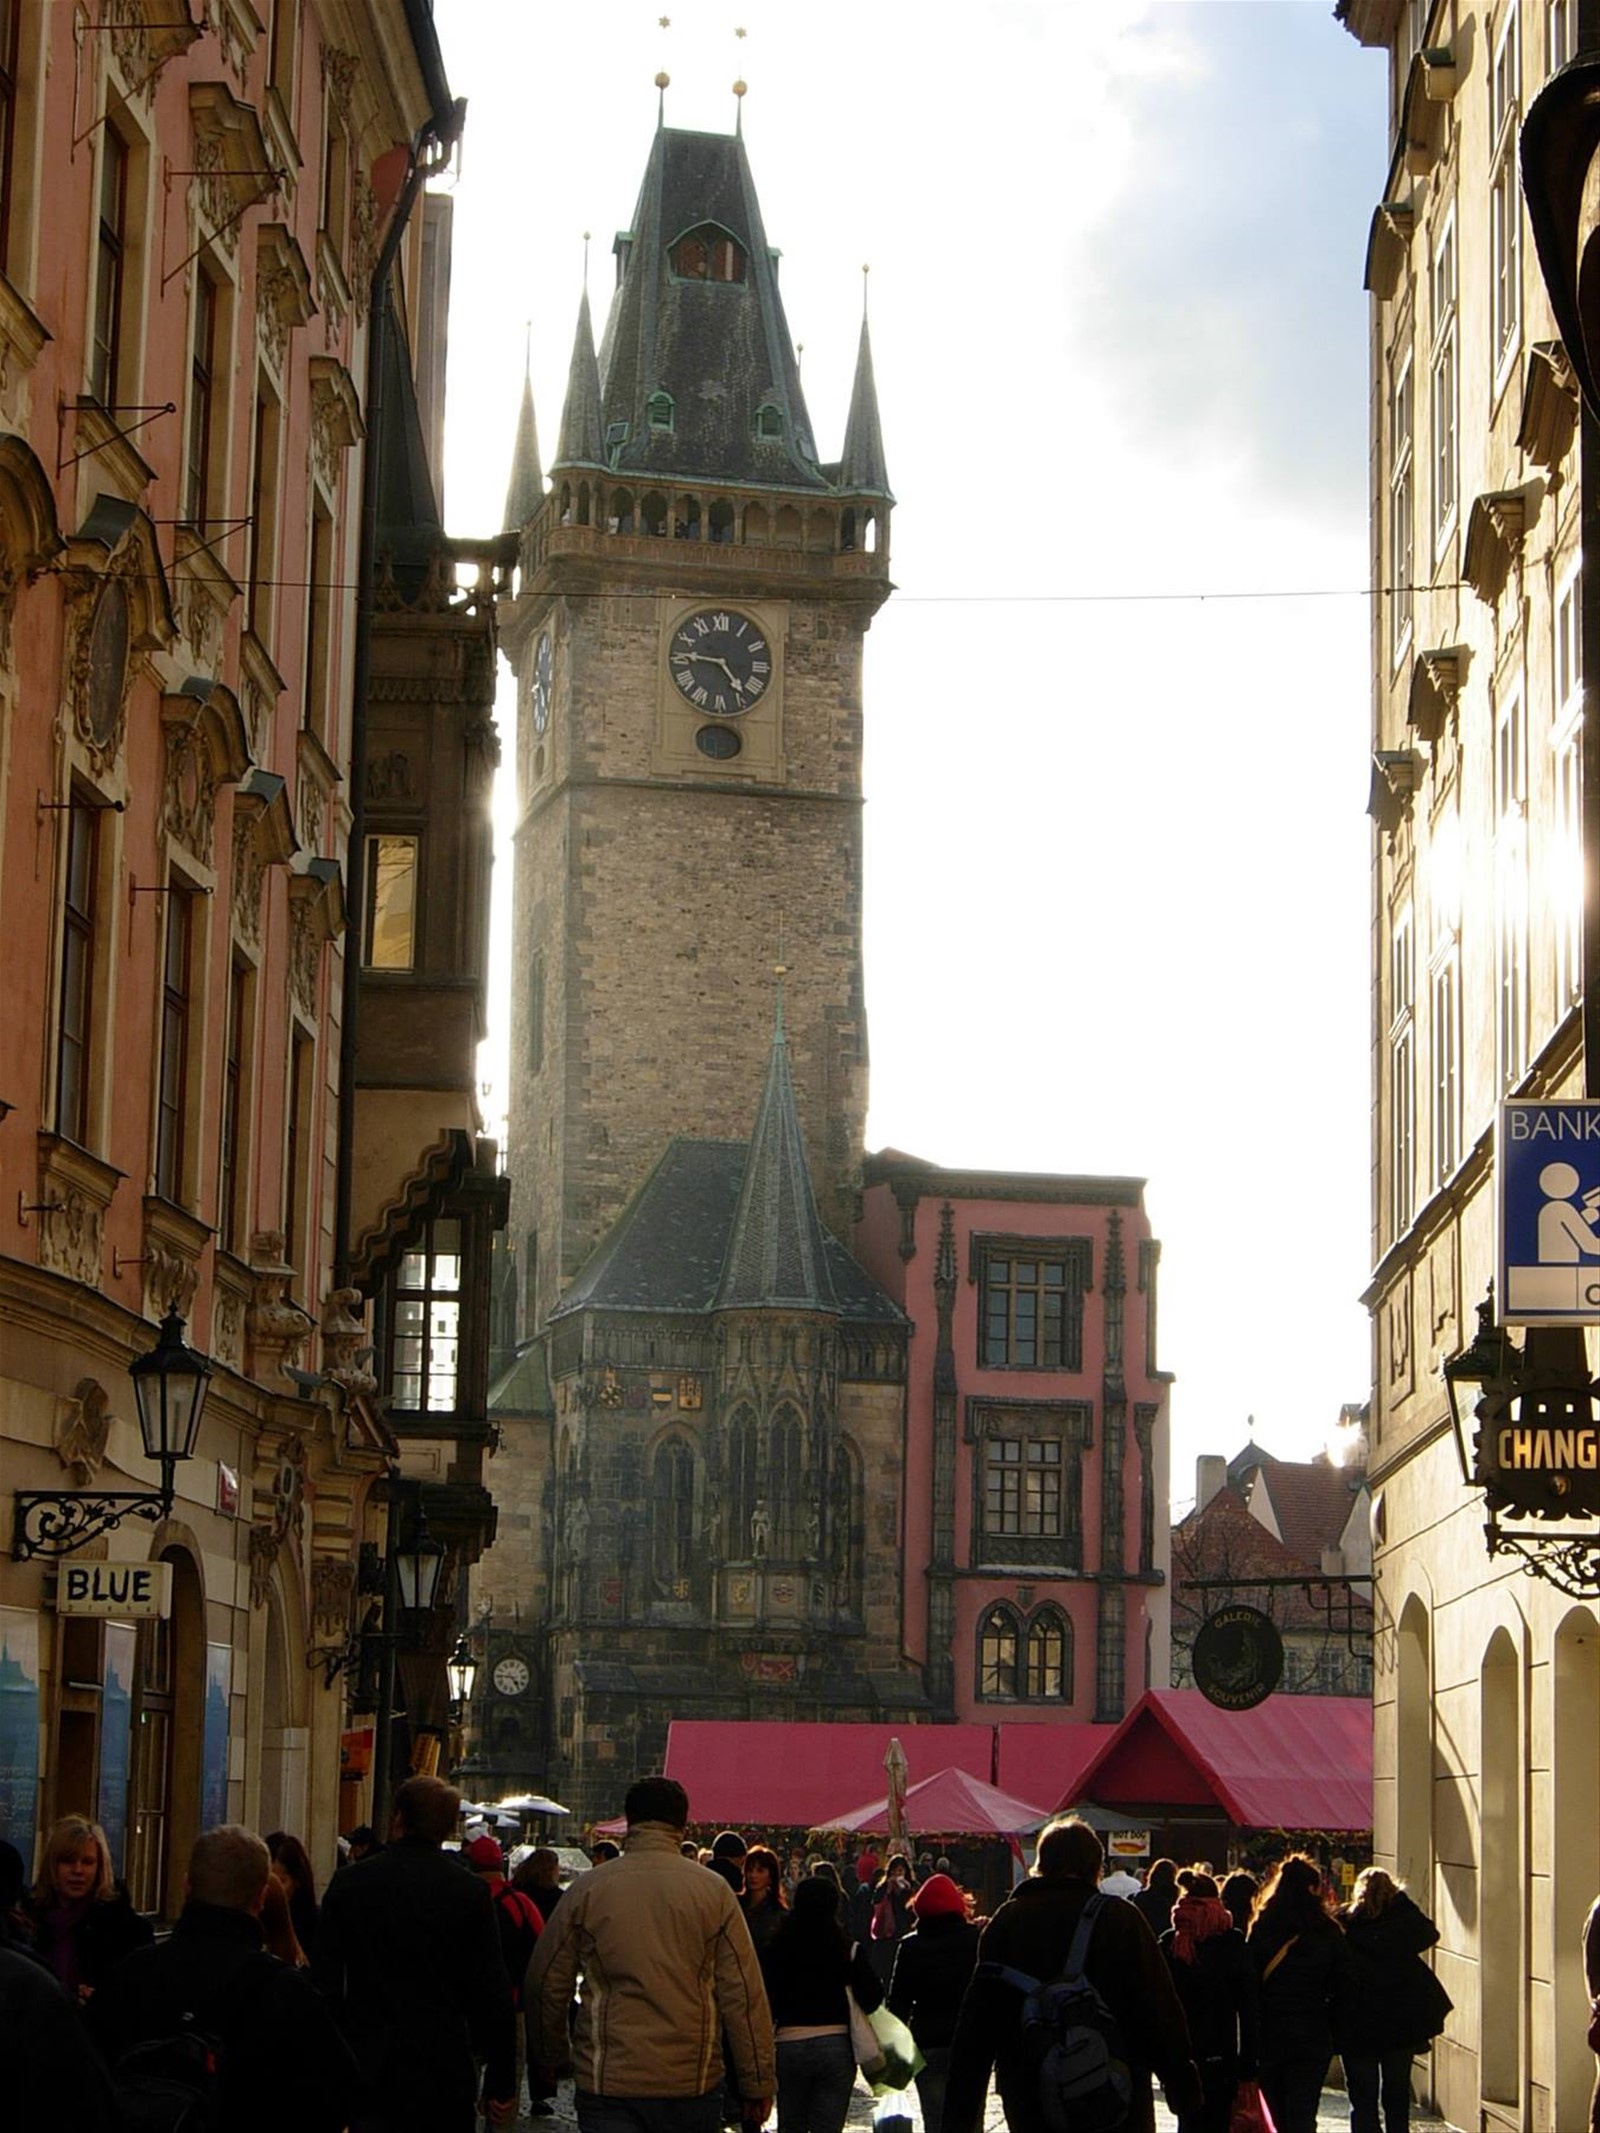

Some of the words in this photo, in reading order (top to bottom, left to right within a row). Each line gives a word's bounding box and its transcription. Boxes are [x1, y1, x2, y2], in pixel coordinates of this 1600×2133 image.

[1511, 1111, 1600, 1140] BANK
[67, 1567, 152, 1604] BLUE
[1130, 1829, 1146, 1840] DOG
